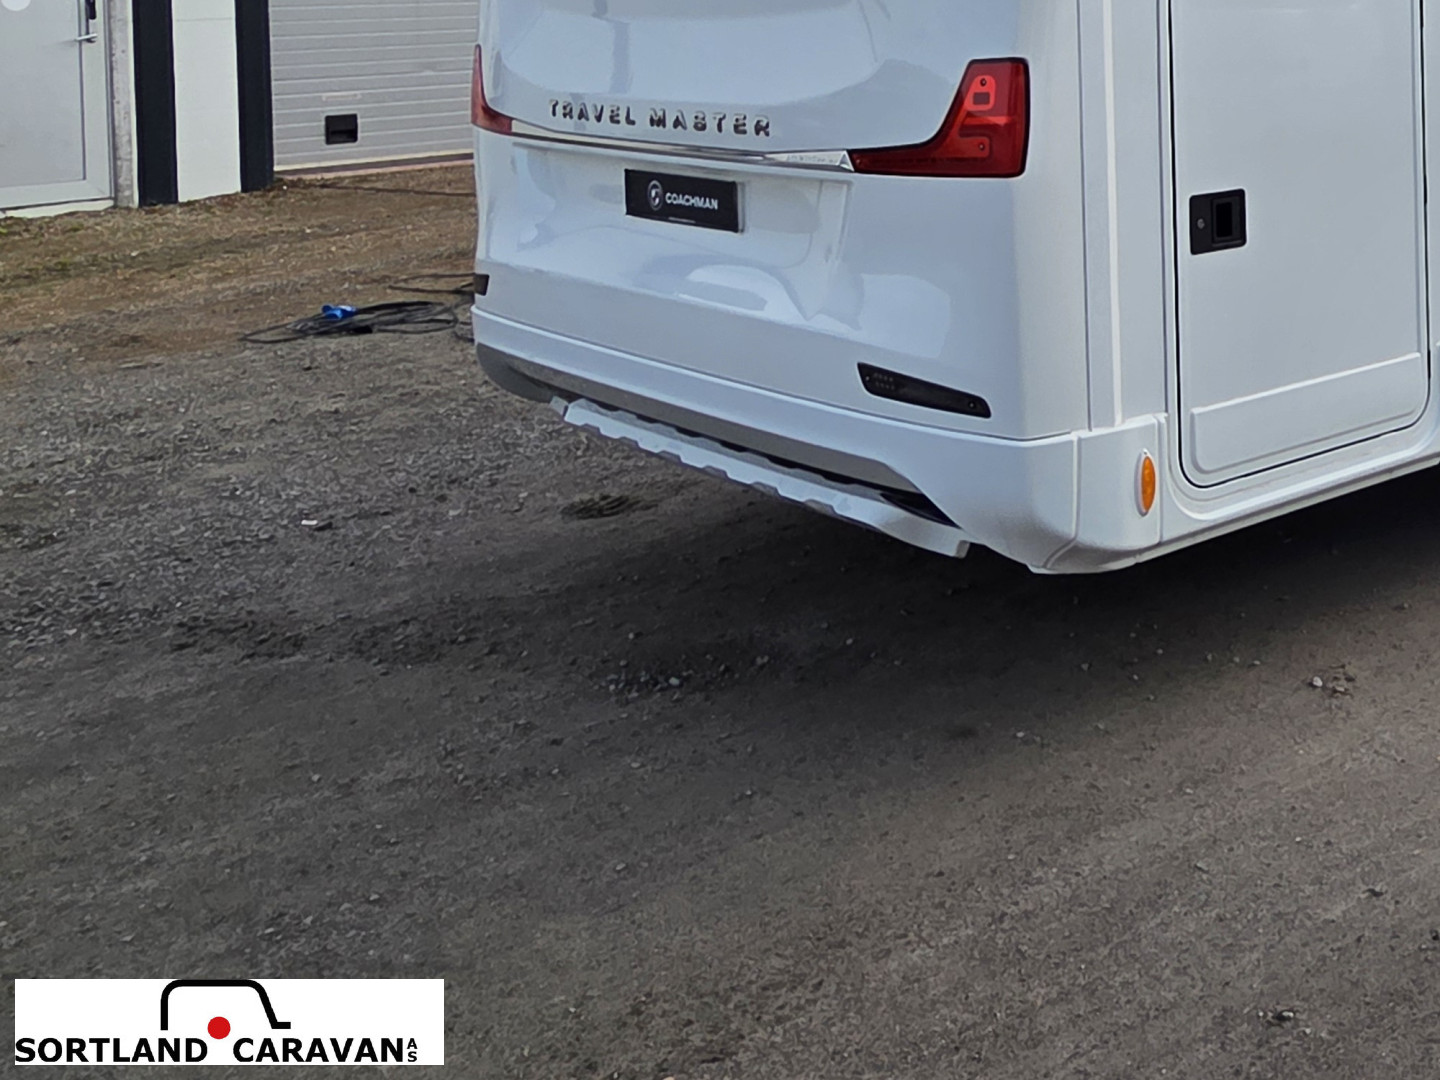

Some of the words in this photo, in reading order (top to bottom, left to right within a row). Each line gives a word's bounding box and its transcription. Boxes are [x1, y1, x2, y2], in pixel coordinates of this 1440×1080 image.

[549, 99, 636, 126] TRAVEL
[649, 107, 770, 137] MASTER
[665, 192, 719, 210] COACHMAN
